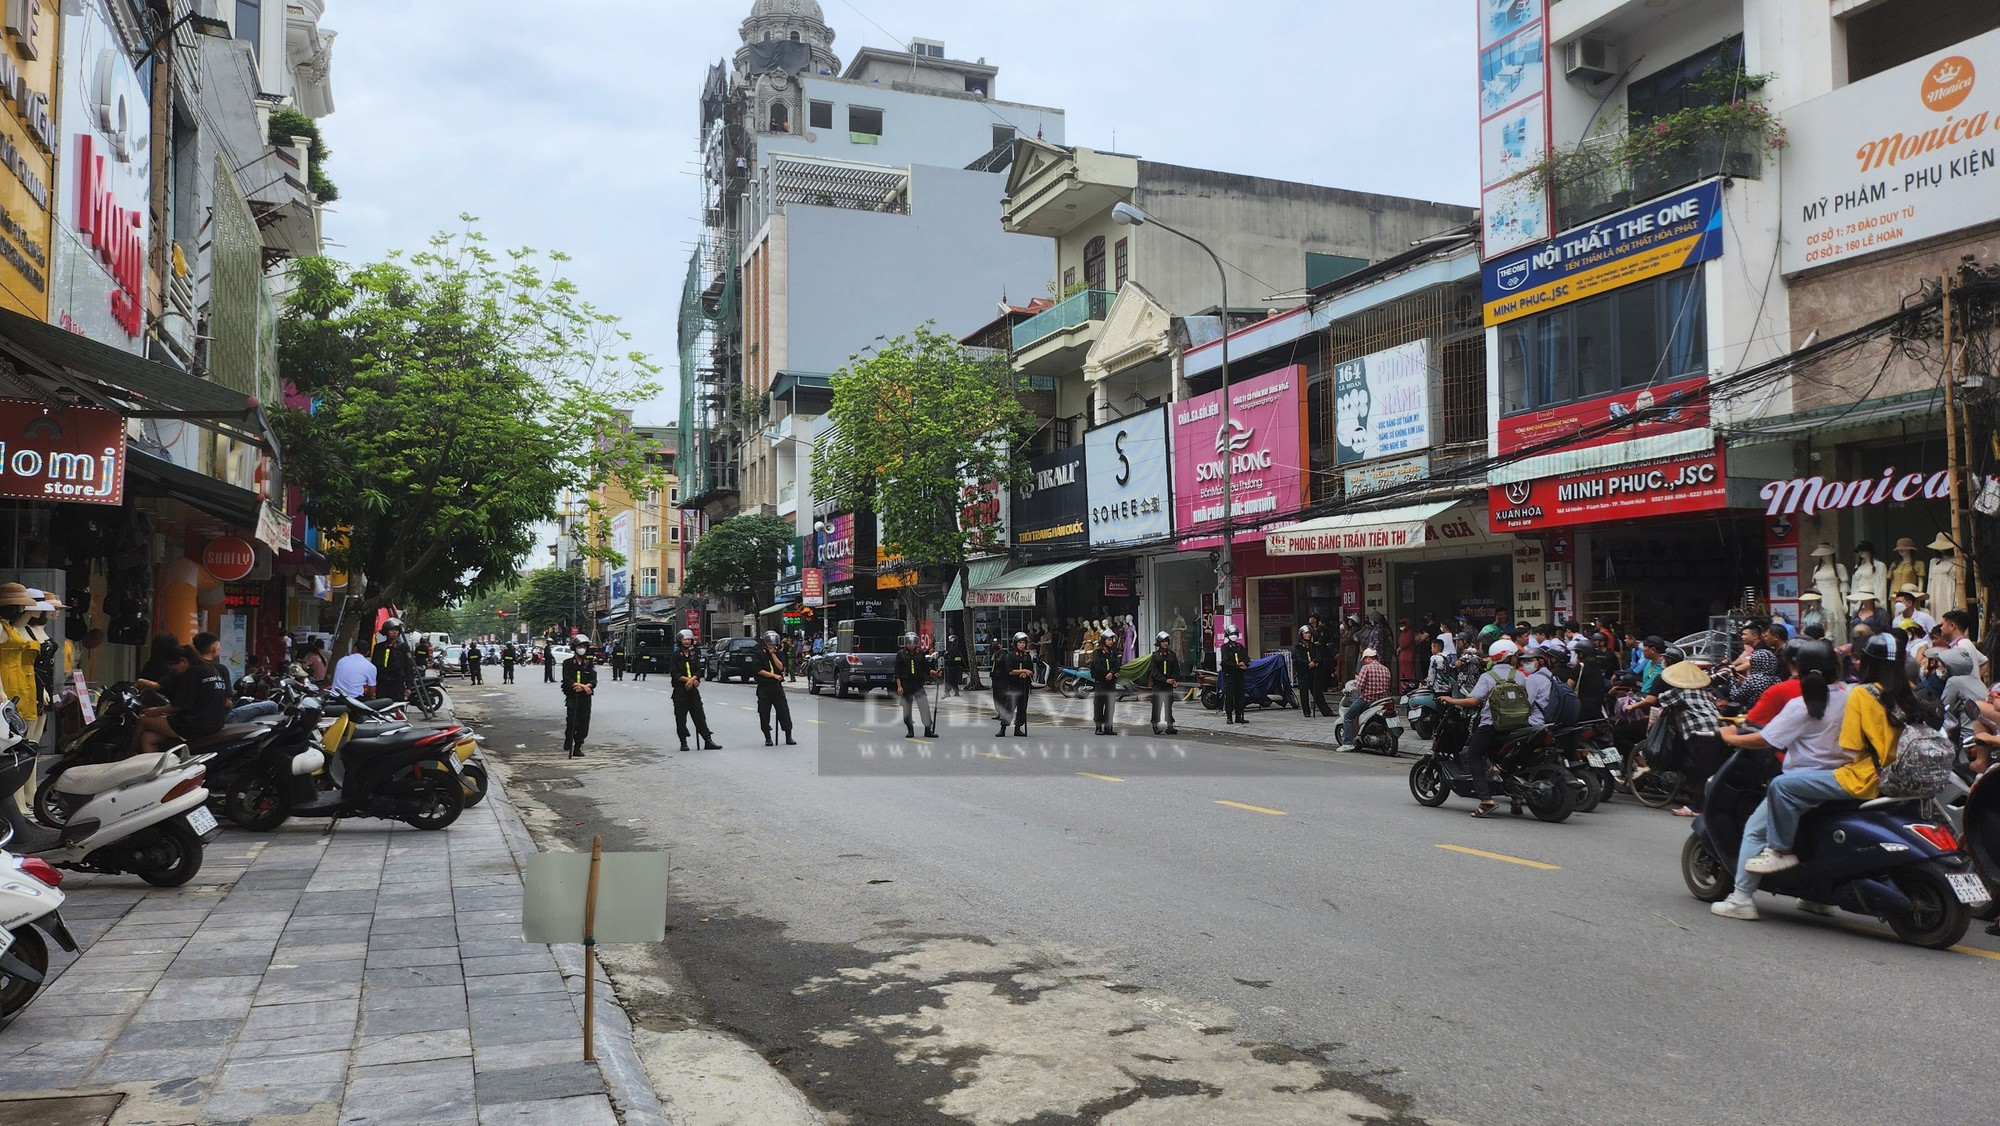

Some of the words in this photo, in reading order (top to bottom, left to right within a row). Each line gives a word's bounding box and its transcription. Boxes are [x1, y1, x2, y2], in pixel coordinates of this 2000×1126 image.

[1926, 76, 1972, 104] Monica
[1856, 110, 1991, 173] Monica
[1802, 196, 1829, 223] MỸ
[1834, 181, 1886, 213] PHẨM
[1904, 164, 1942, 192] PHỤ
[1950, 148, 1996, 180] KIỆN
[1846, 223, 1856, 235] 73
[1858, 214, 1878, 232] ĐÀO
[1880, 212, 1899, 226] DUY
[1902, 204, 1916, 218] TỪ
[1532, 245, 1562, 271] NỘI
[1564, 224, 1613, 259] THẤT
[1617, 214, 1655, 241] THE
[1658, 198, 1700, 227] ONE
[1615, 244, 1630, 255] NỘI
[1674, 219, 1699, 236] PHÁT
[1863, 232, 1875, 247] LÊ
[1876, 227, 1904, 242] HOÀN
[1493, 301, 1518, 318] MINH
[1337, 362, 1362, 385] 164
[44, 481, 95, 496] store
[1558, 479, 1603, 502] MINH
[1759, 466, 1958, 516] Monica
[1093, 498, 1138, 524] SOHEE
[1318, 532, 1341, 550] RĂNG
[1391, 529, 1406, 546] THI
